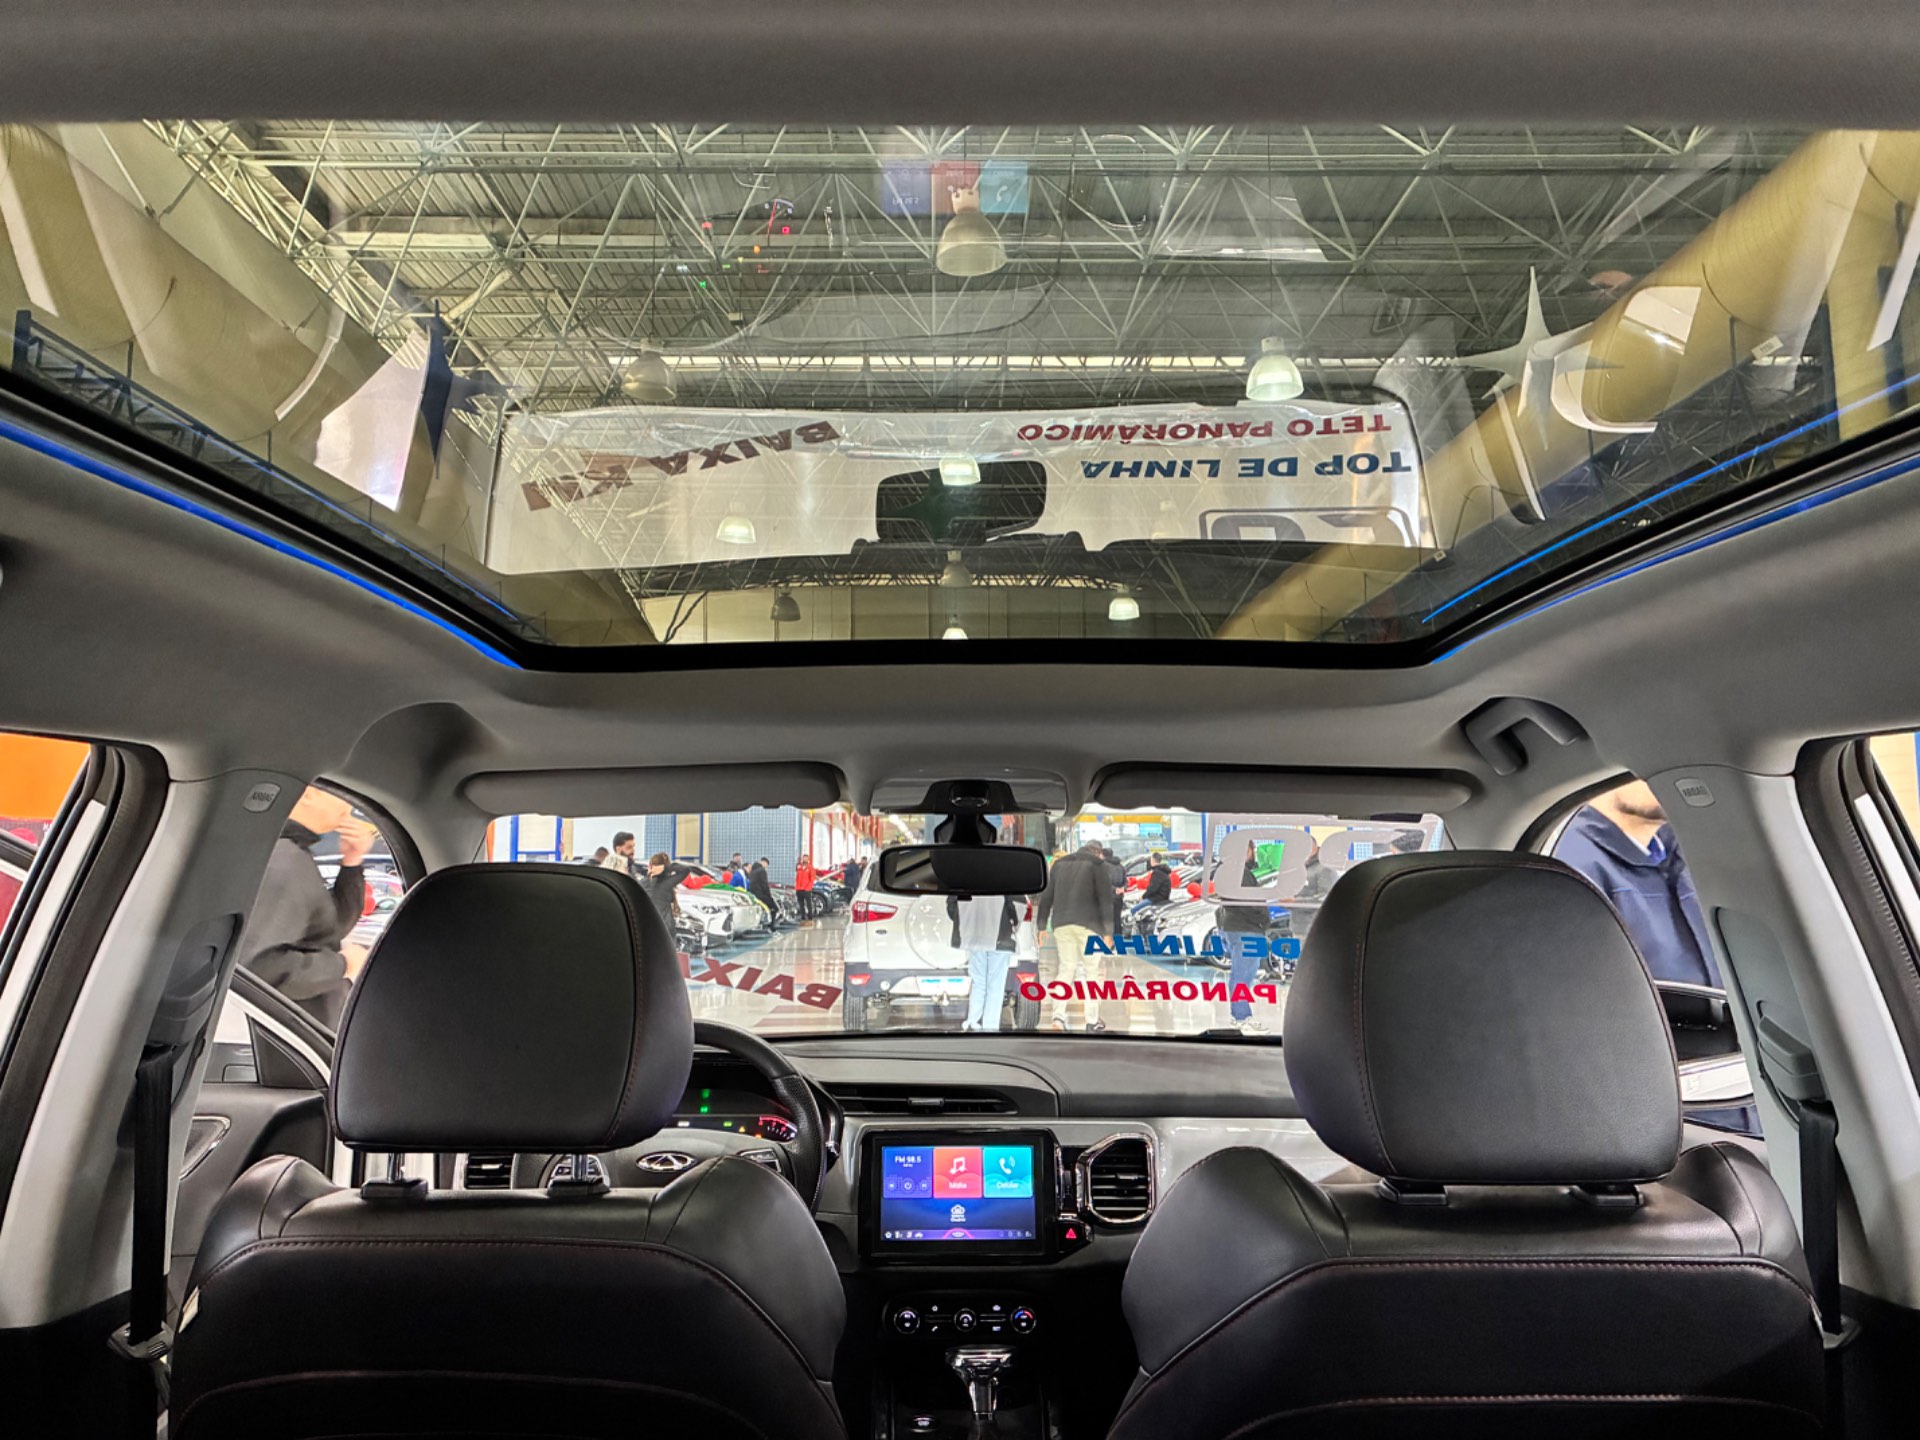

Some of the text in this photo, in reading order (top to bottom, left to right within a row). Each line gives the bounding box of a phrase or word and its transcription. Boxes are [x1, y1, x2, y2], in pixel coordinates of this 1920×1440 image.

[1017, 414, 1392, 445] TETO PANORÂMICO
[649, 420, 841, 475] BAIXA
[1081, 451, 1412, 478] TOP DE LINHA
